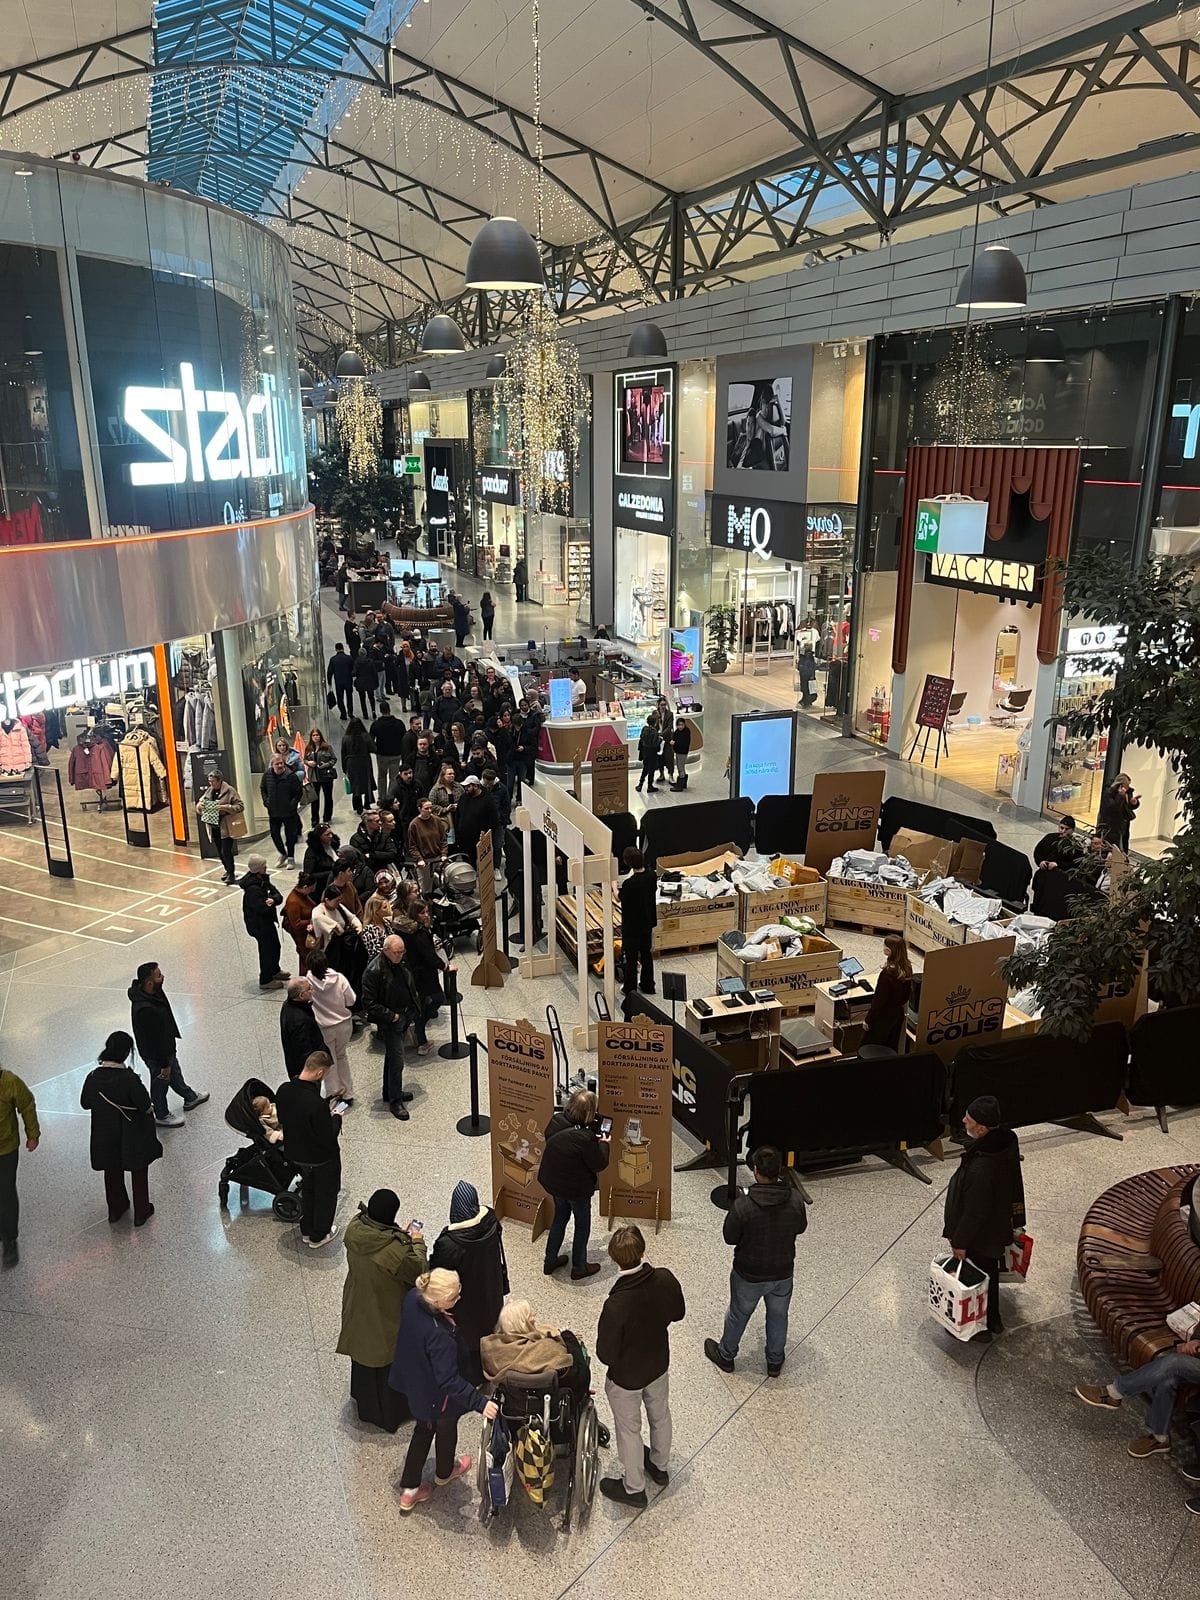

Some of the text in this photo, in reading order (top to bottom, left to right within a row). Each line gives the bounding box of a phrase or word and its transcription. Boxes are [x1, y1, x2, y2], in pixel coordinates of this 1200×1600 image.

[482, 473, 509, 495] panduro
[618, 492, 664, 513] CALZEDONIA
[727, 504, 772, 560] MQ
[936, 553, 1029, 591] VACKER
[0, 652, 157, 720] tadium
[596, 755, 625, 763] COLIS
[815, 805, 875, 822] KING
[814, 820, 872, 833] COLIS
[831, 879, 885, 891] CARGAISON
[707, 901, 735, 911] COLIS
[751, 899, 801, 915] CARGAISON
[910, 912, 934, 931] STOCK
[749, 973, 808, 989] CARGAISON
[927, 996, 1004, 1031] KING
[493, 1025, 546, 1050] KING
[605, 1025, 665, 1042] KING
[926, 1015, 1001, 1044] COLIS
[494, 1039, 545, 1060] COLIS
[605, 1039, 664, 1052] COLIS
[491, 1058, 531, 1074] BORTTAPPADE
[601, 1060, 648, 1069] BORTTAPPADE
